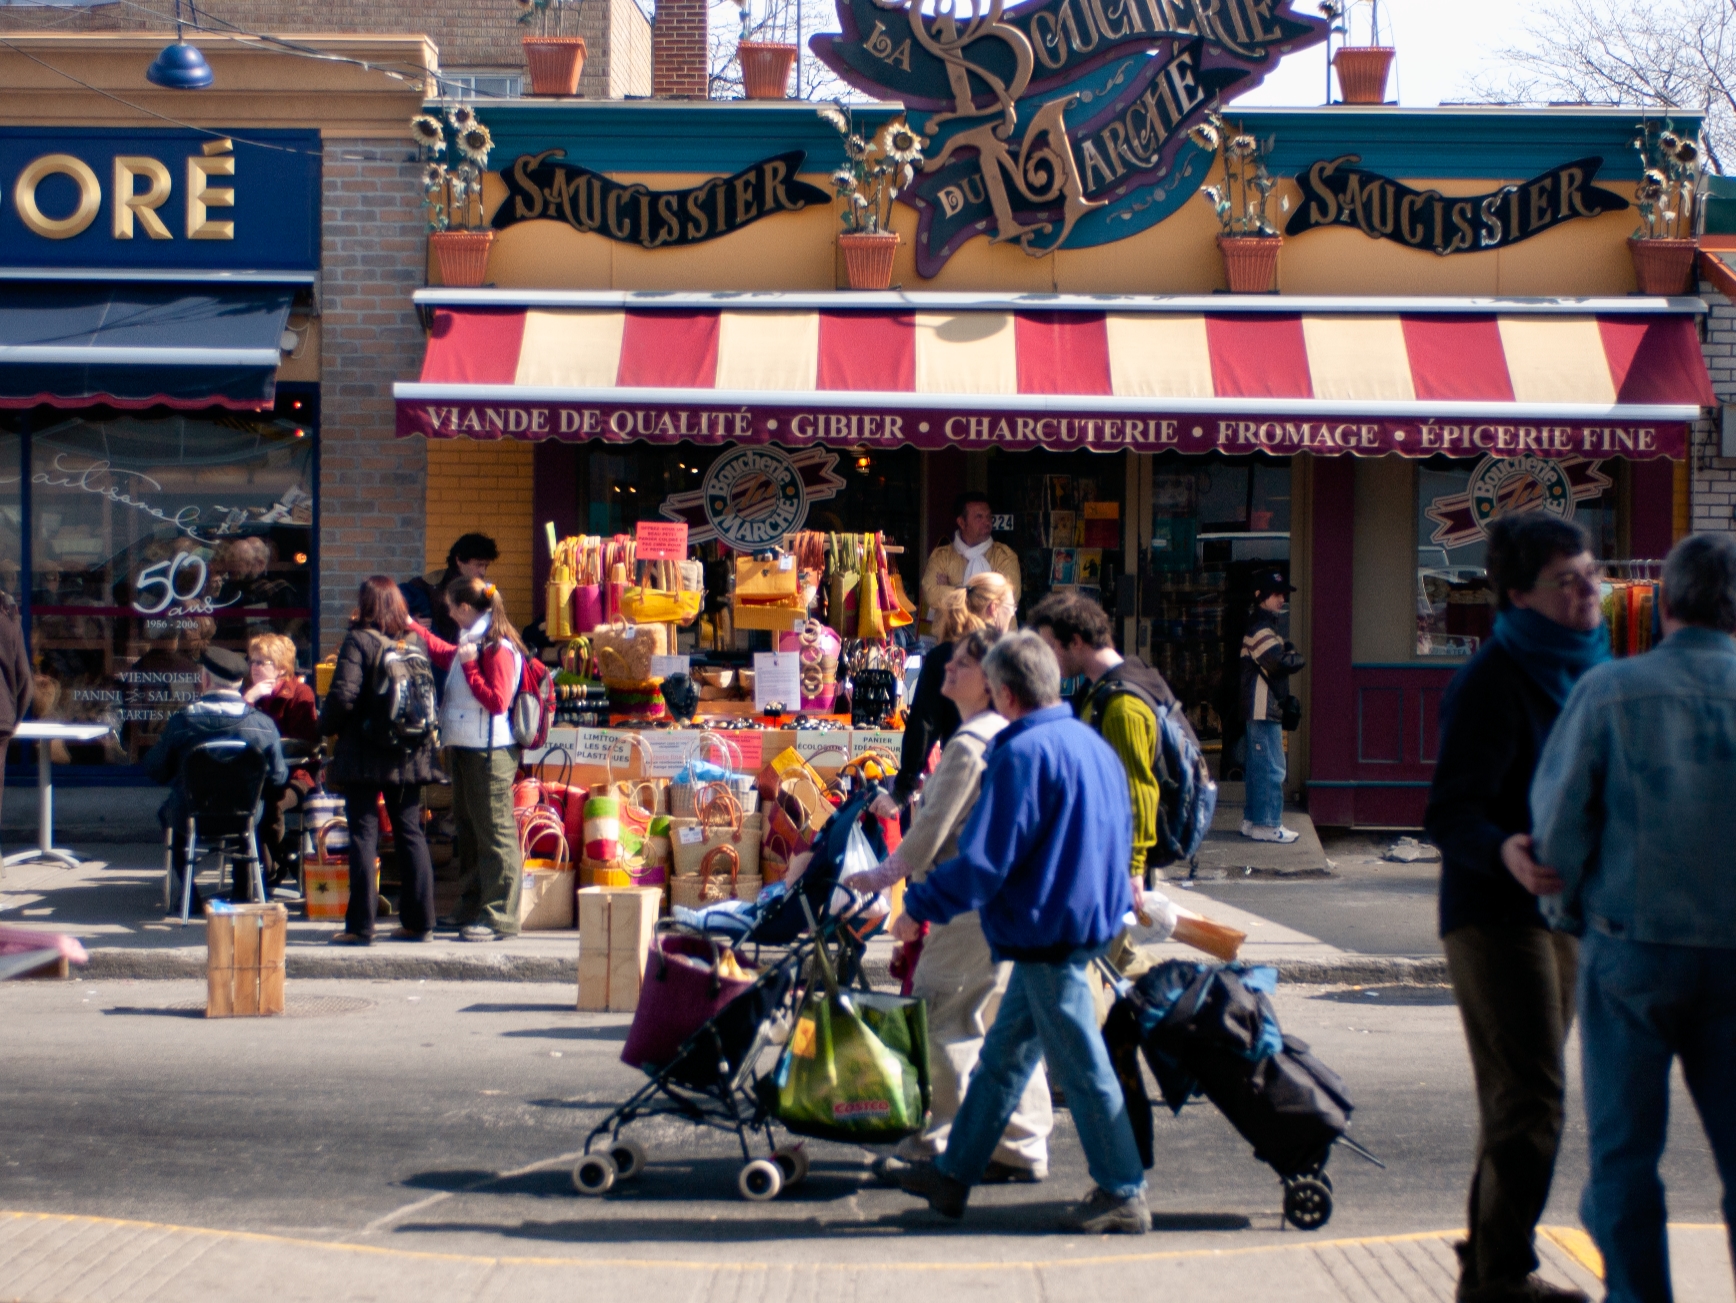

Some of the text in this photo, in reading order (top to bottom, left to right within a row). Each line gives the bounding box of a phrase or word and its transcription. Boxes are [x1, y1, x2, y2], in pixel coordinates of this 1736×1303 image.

[863, 20, 912, 72] LA
[922, 41, 1205, 258] DU MARCHÉ
[0, 138, 235, 240] ORÉ
[514, 149, 804, 248] SAUCISSIER
[1310, 155, 1600, 256] SAUCISSIER
[427, 406, 1656, 451] VIANDE DE QUALITÉ GIBIER CHARCUTERIE FROMAGE ÉPICERIE FINE
[709, 451, 792, 497] Boucherie
[133, 552, 206, 613] 50
[146, 619, 168, 629] 1956
[176, 619, 199, 629] 2006
[74, 690, 121, 701] PANINI
[119, 672, 202, 683] VIENNOISER
[120, 710, 164, 721] TARTES
[576, 751, 630, 763] PLASTIUES
[863, 736, 893, 744] PANIER
